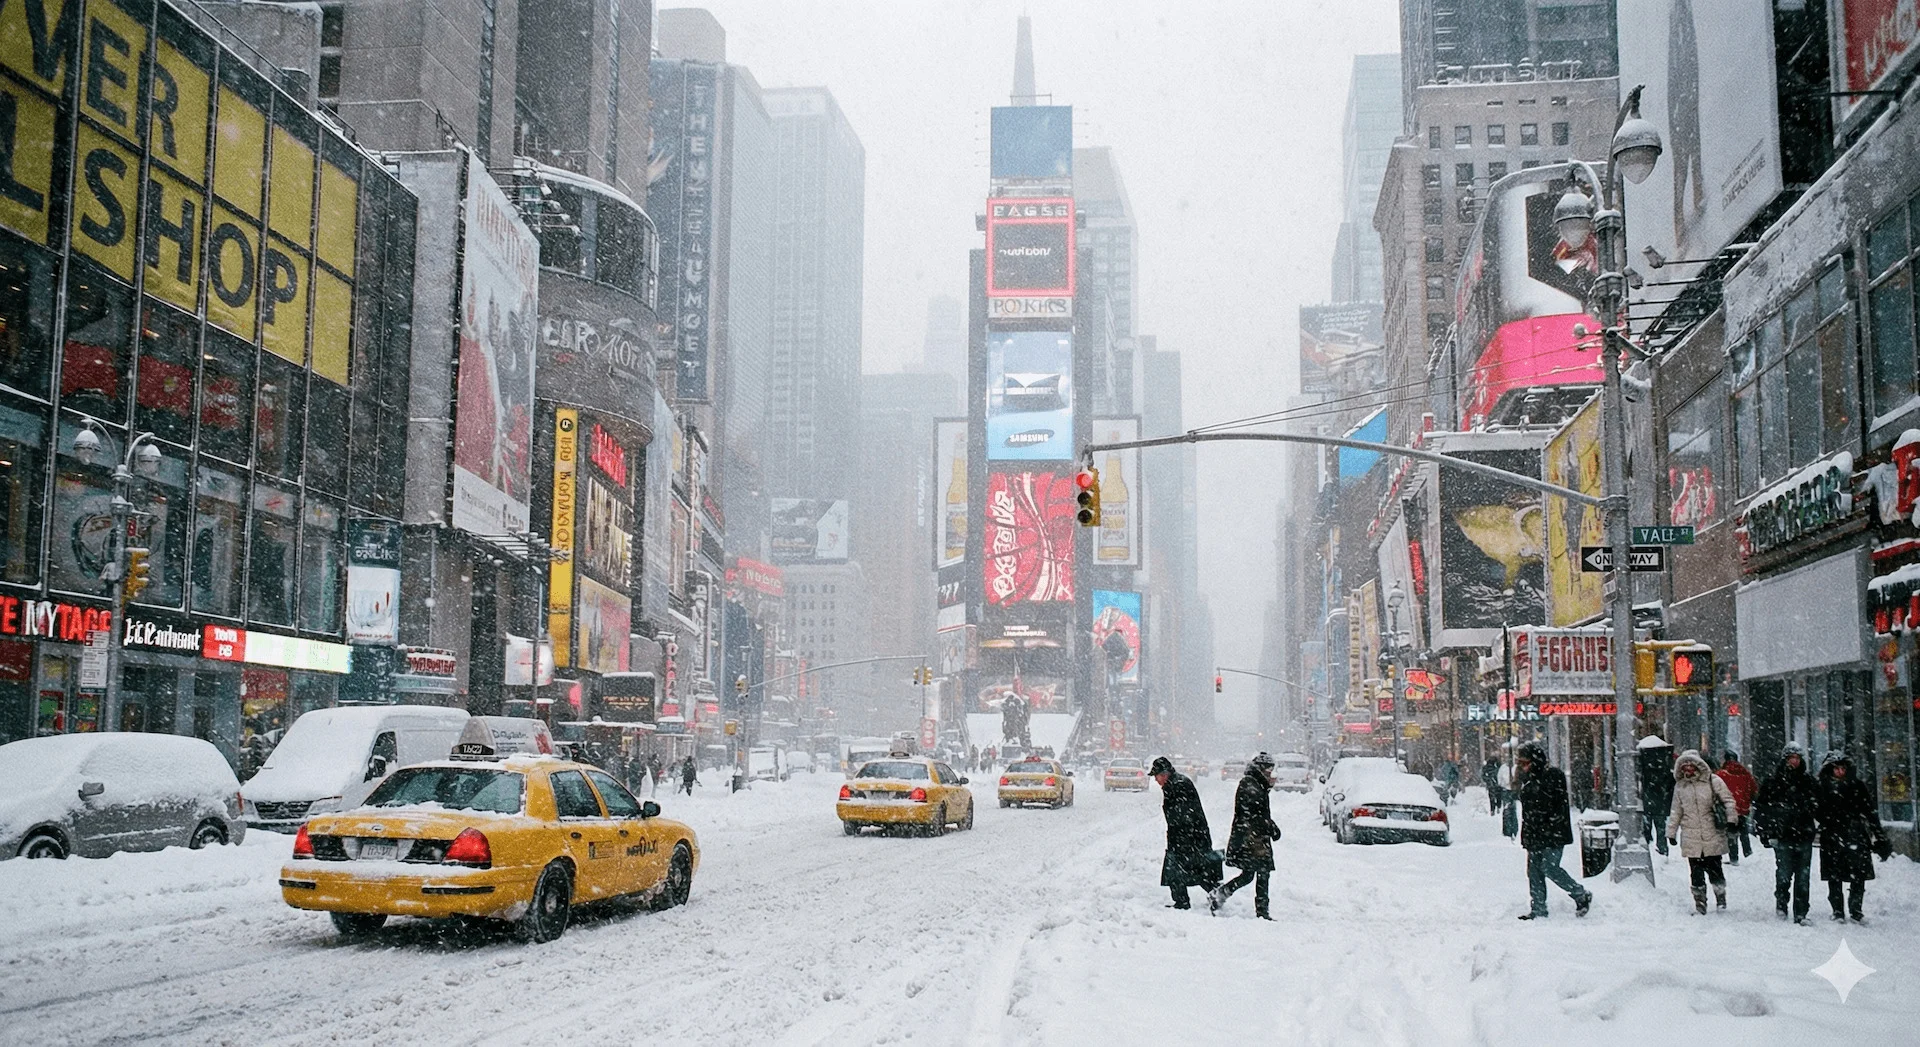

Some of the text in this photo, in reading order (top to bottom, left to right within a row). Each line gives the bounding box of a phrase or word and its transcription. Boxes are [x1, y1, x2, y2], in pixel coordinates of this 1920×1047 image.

[78, 147, 299, 327] SHOP
[1594, 552, 1654, 565] ON WAY
